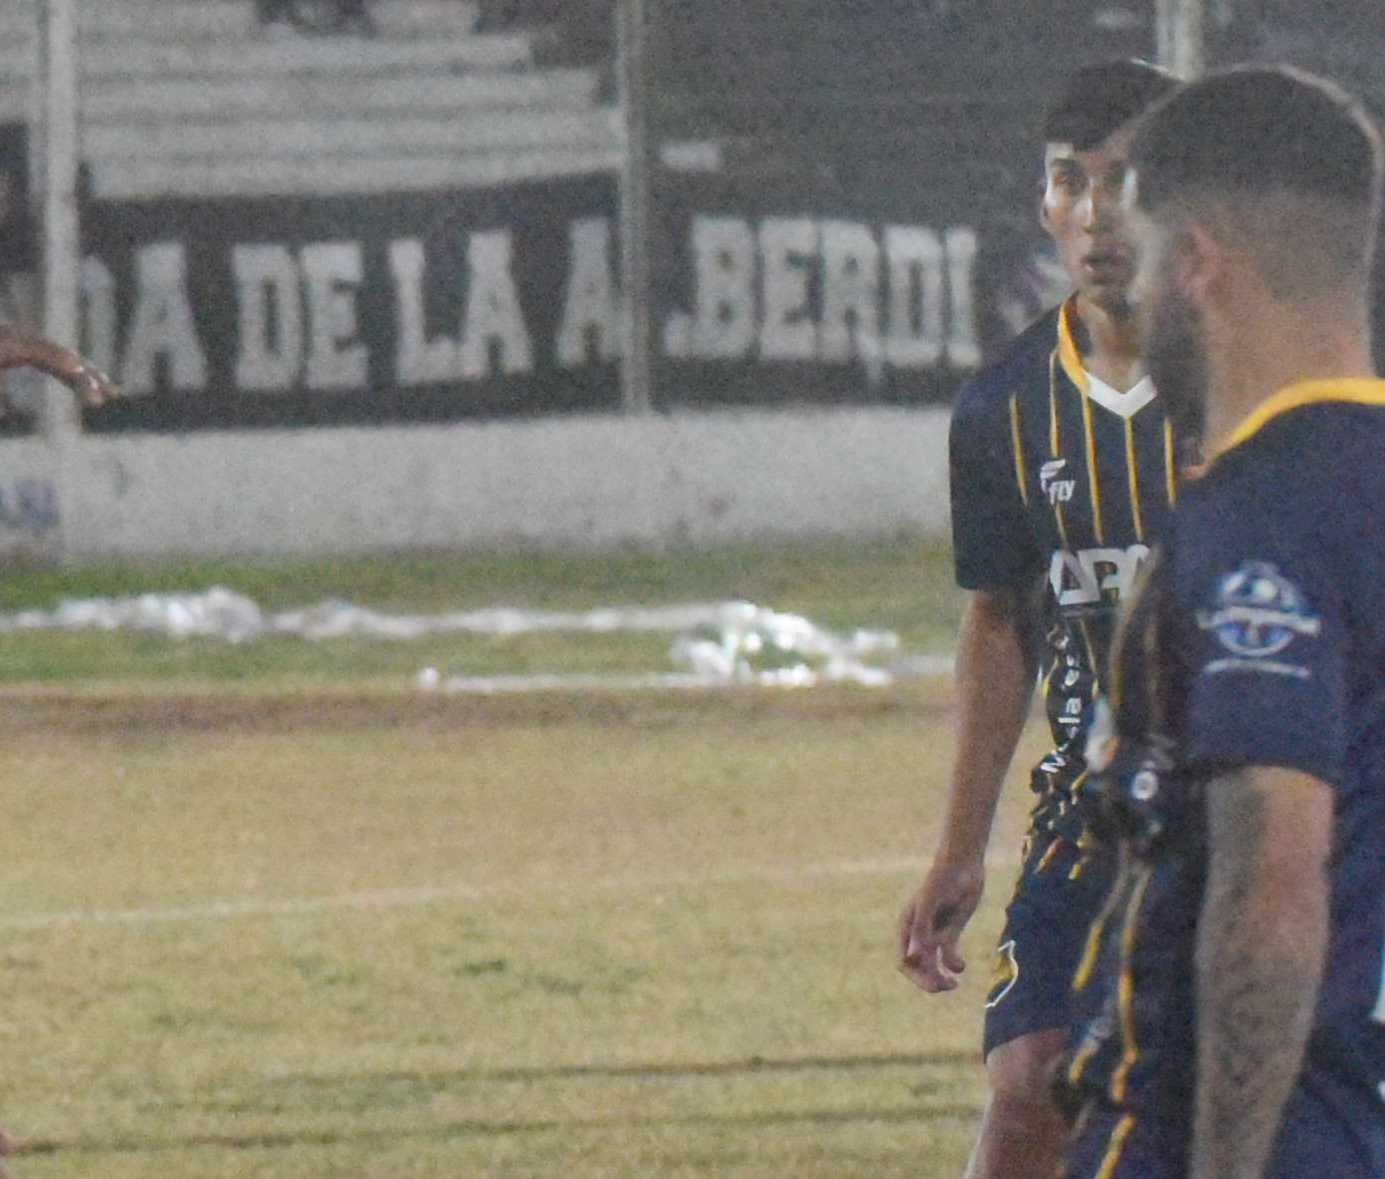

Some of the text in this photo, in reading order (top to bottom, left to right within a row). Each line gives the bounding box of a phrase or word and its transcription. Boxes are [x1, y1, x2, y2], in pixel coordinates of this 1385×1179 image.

[232, 241, 368, 392] DE
[387, 227, 532, 384] LA
[556, 214, 983, 385] ABERDI
